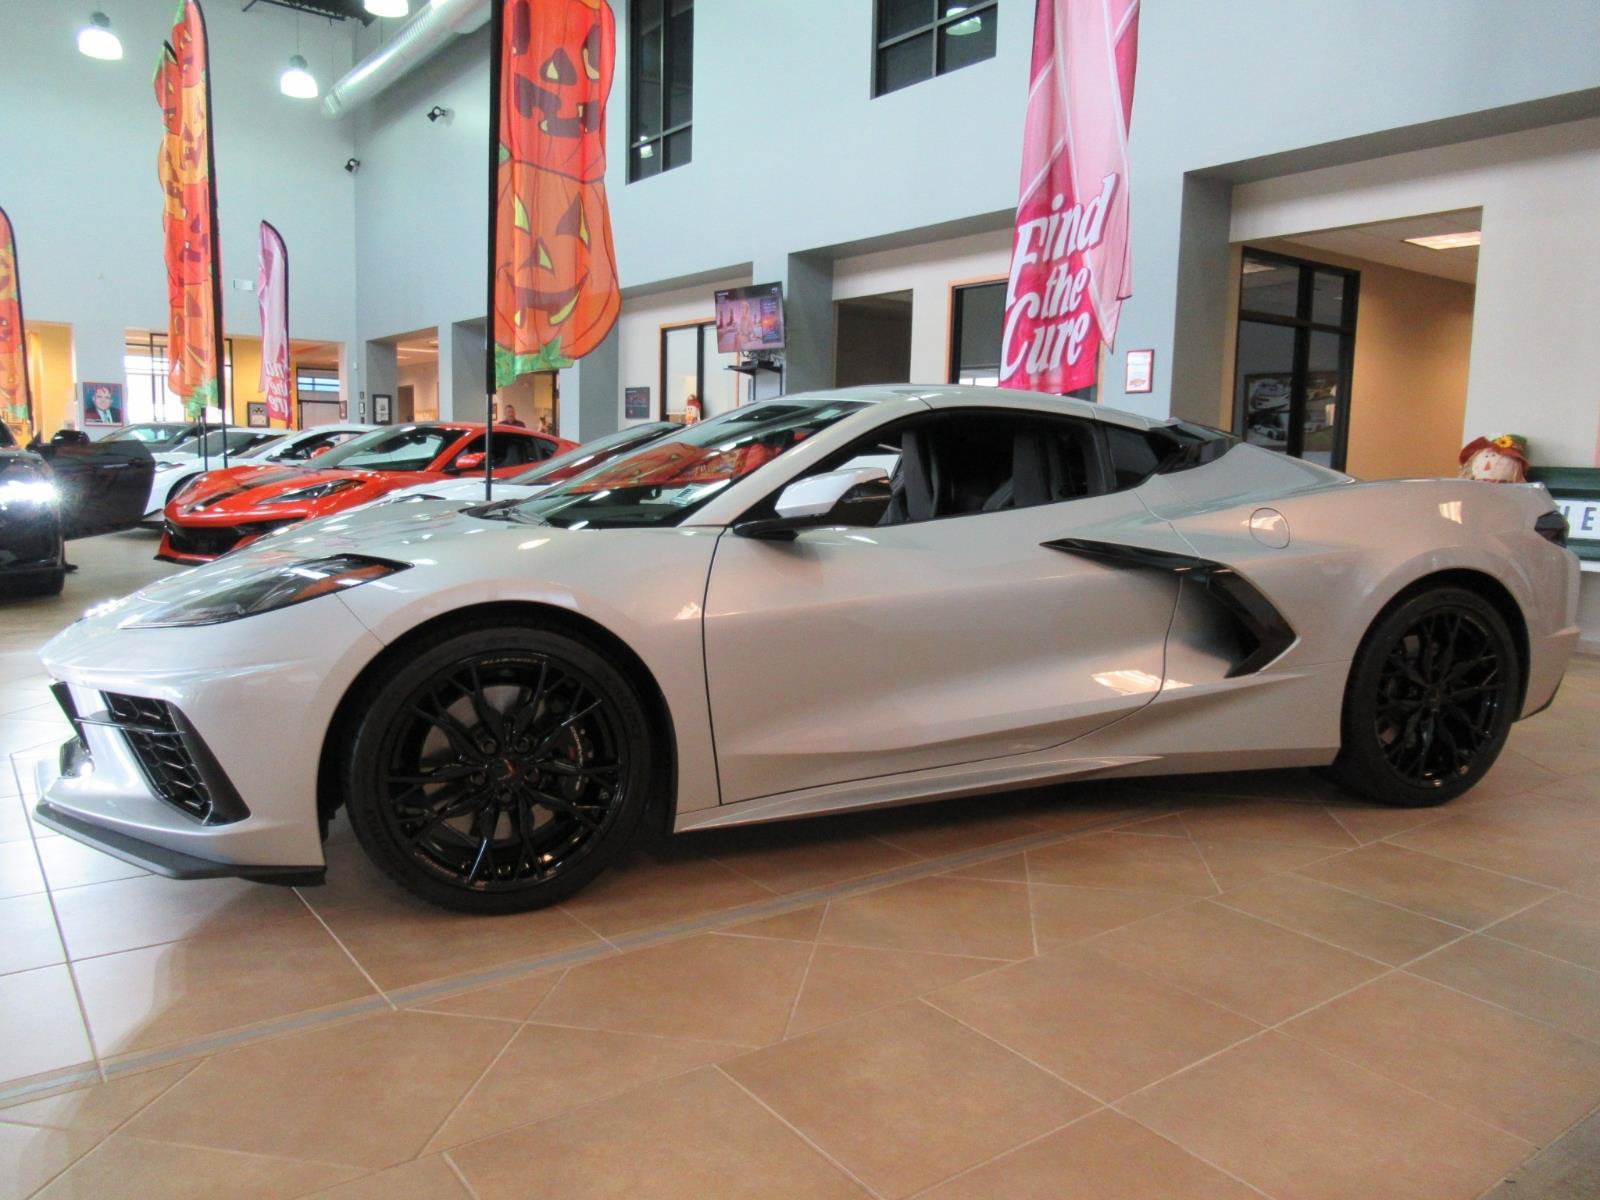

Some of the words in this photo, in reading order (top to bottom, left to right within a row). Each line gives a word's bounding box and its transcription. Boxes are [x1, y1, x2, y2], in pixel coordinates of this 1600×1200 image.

[1005, 172, 1120, 312] Find
[1041, 261, 1089, 320] the
[1001, 292, 1091, 382] Cure
